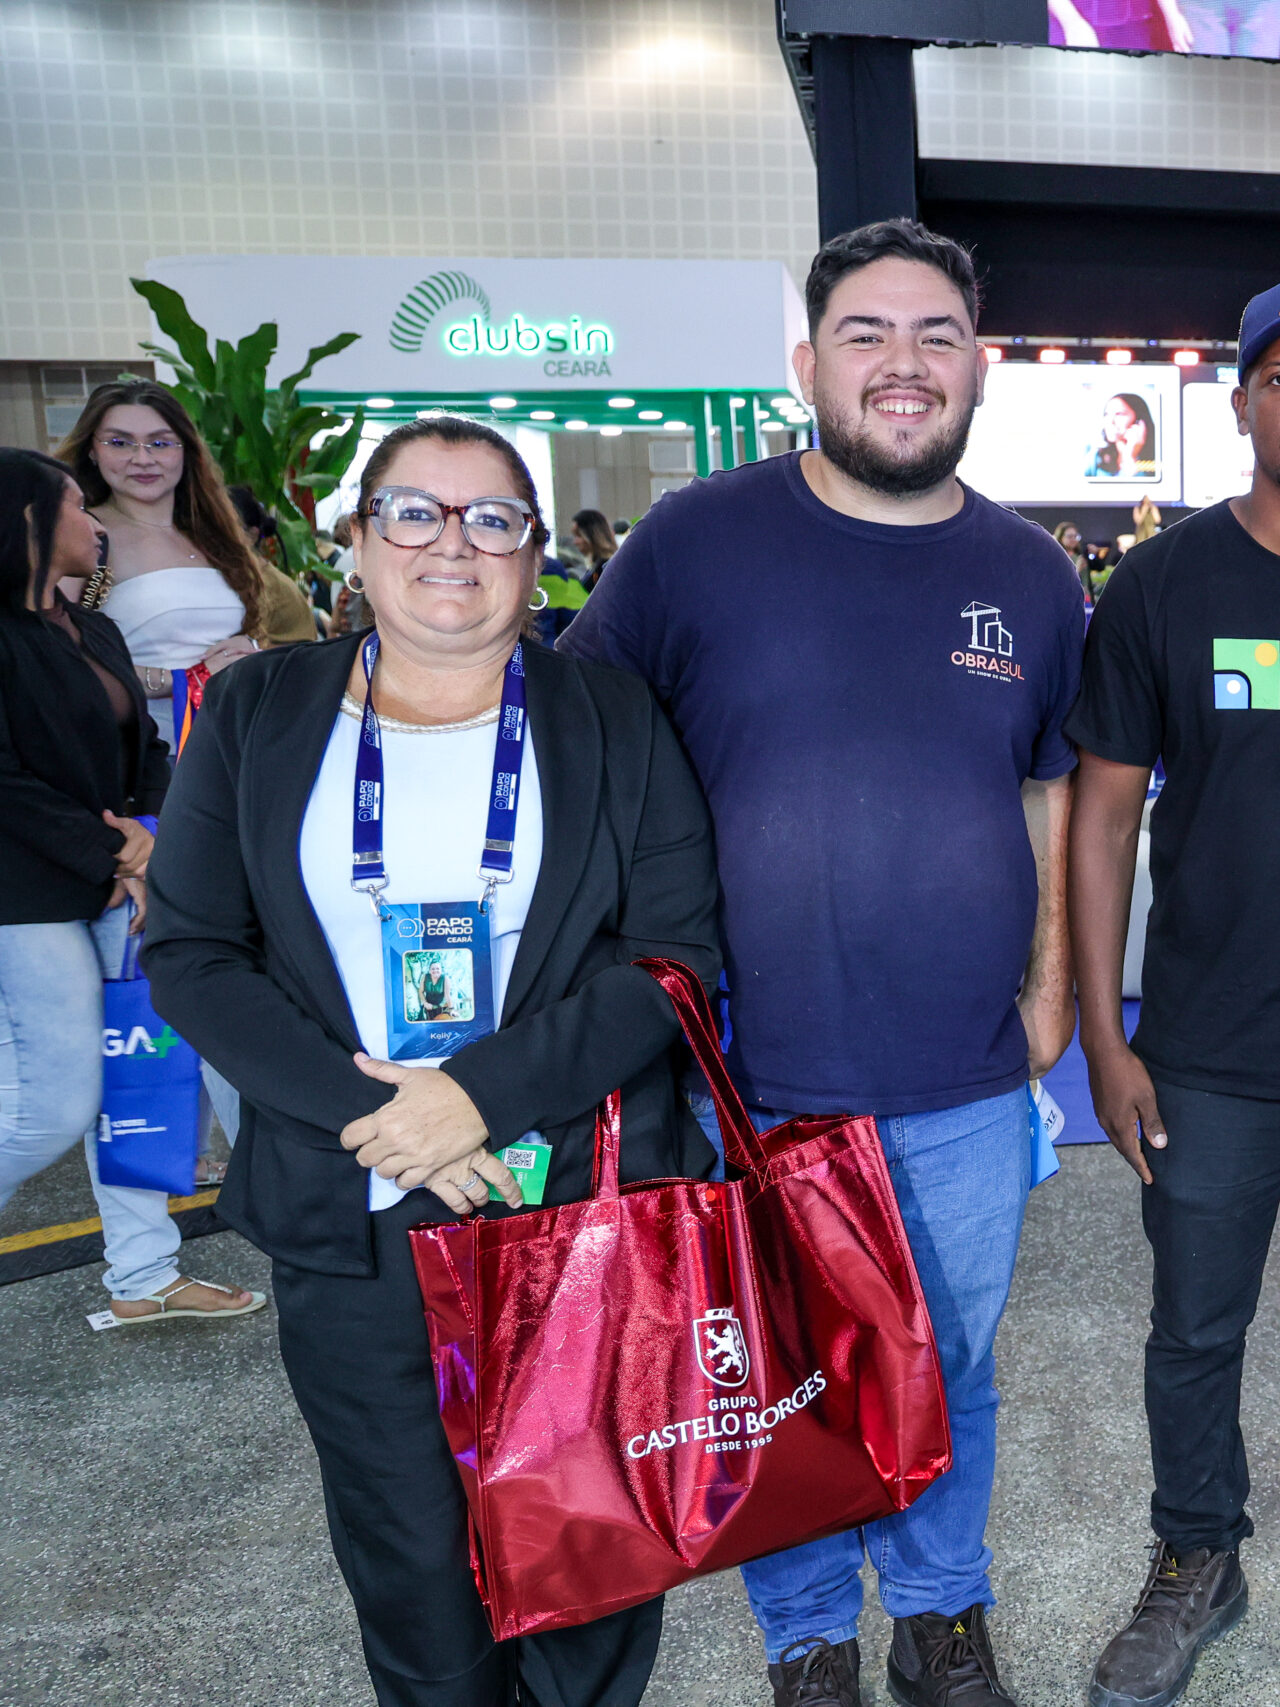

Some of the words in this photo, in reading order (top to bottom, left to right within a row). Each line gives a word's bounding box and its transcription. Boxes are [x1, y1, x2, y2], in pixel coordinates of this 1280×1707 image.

[448, 316, 612, 353] clubsin
[543, 356, 612, 377] CEARÁ
[951, 651, 1025, 680] OBRASUL
[504, 704, 512, 727] PAPO
[359, 779, 367, 807] PAPO
[495, 772, 504, 796] PAPO
[502, 772, 511, 796] CONDO
[427, 917, 473, 928] PAPO
[427, 926, 473, 936] CONDO
[447, 935, 473, 943] CEARÁ
[430, 1032, 452, 1041] Kelly
[627, 1413, 740, 1459] CASTELO
[745, 1370, 827, 1435] BORGES
[708, 1396, 758, 1412] GRUPO
[705, 1440, 742, 1454] DESDE
[744, 1433, 773, 1449] 1995
